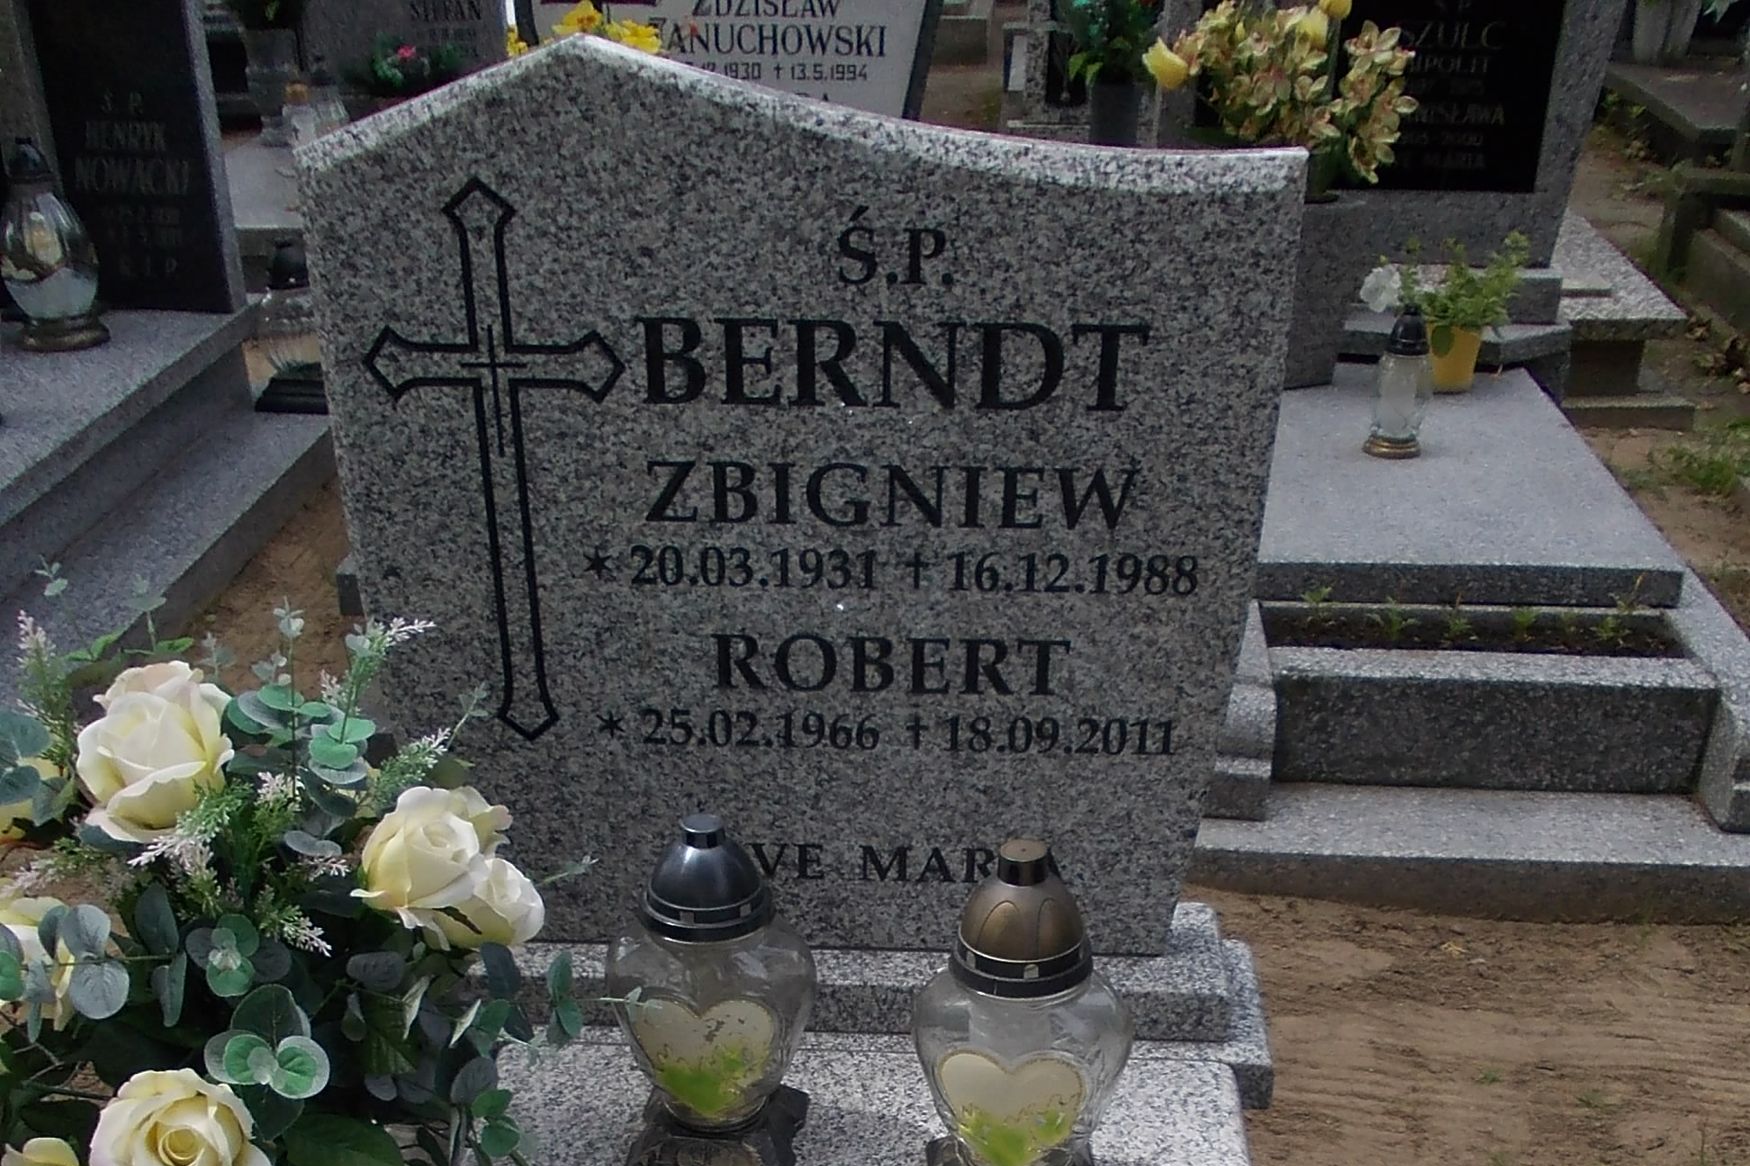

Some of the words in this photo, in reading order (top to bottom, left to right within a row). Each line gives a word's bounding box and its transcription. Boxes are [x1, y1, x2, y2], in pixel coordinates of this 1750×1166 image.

[634, 316, 1150, 412] BERNDT
[645, 460, 1139, 530] ZBIGNIEW
[630, 545, 879, 589] 20.03.1931
[947, 550, 1199, 597] 16.12.1988
[710, 633, 1071, 697] ROBERT
[642, 708, 881, 751] 25.02.1966
[942, 714, 1176, 756] 18.09.2011
[745, 843, 825, 881] VE
[858, 845, 1064, 884] MAR
